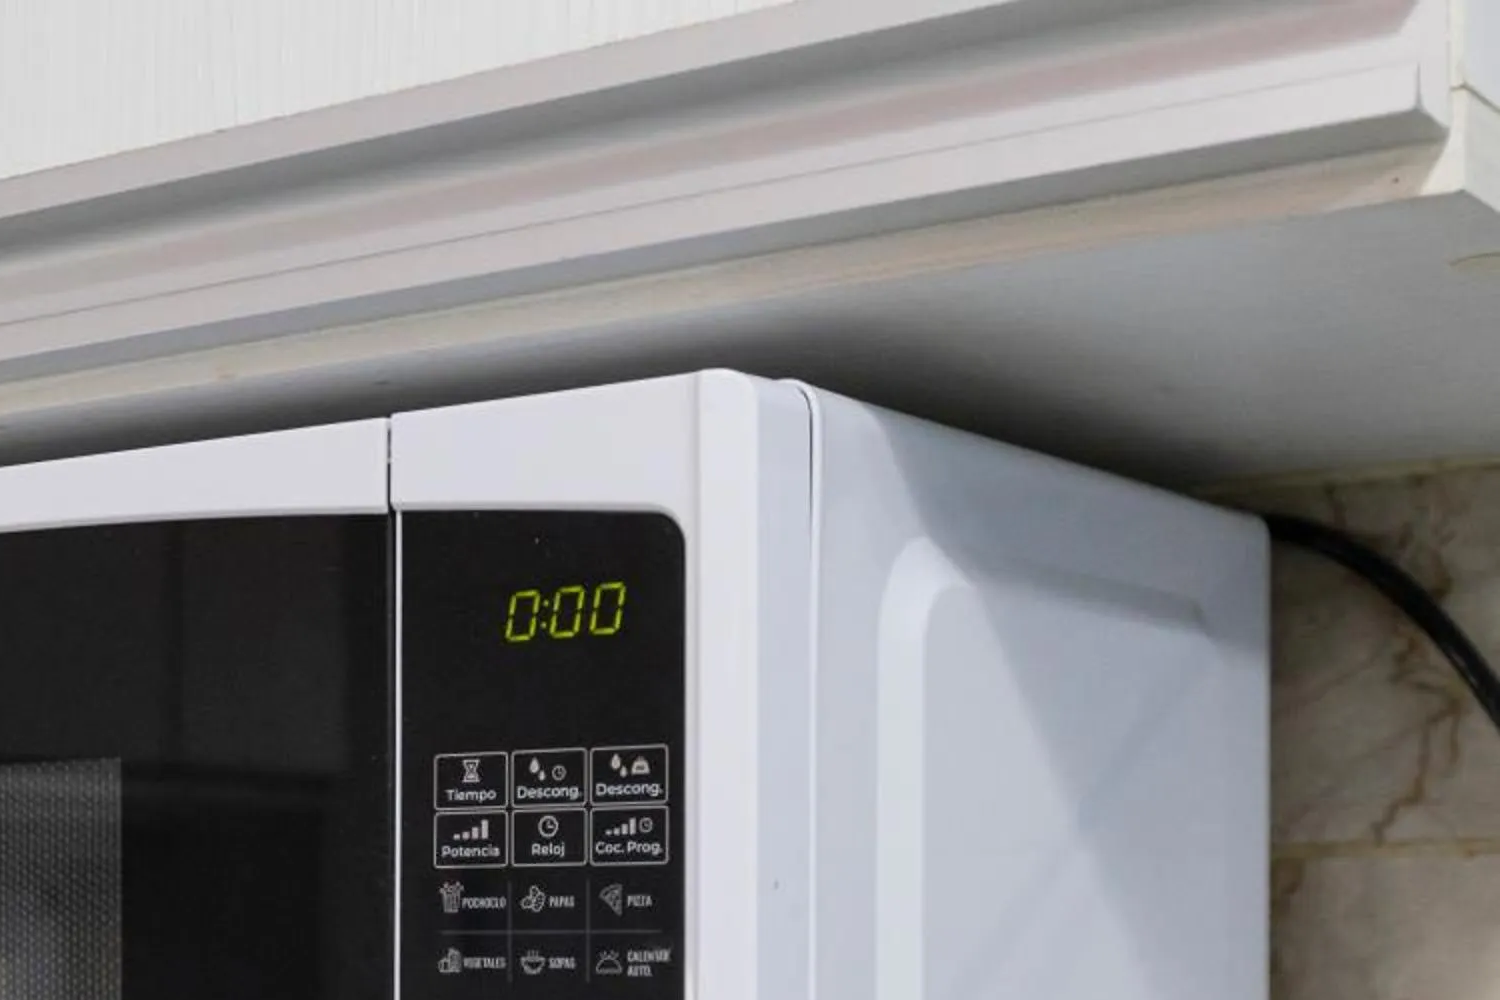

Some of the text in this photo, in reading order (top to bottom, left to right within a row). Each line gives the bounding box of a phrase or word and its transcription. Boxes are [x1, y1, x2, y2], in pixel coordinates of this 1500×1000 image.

[505, 581, 626, 642] 0:00
[445, 788, 497, 803] Tiempo
[516, 785, 582, 801] Descong.
[595, 782, 664, 798] Descong.
[441, 845, 501, 859] Potencia
[531, 843, 566, 858] Reloj
[595, 840, 663, 857] Coc. Prog.
